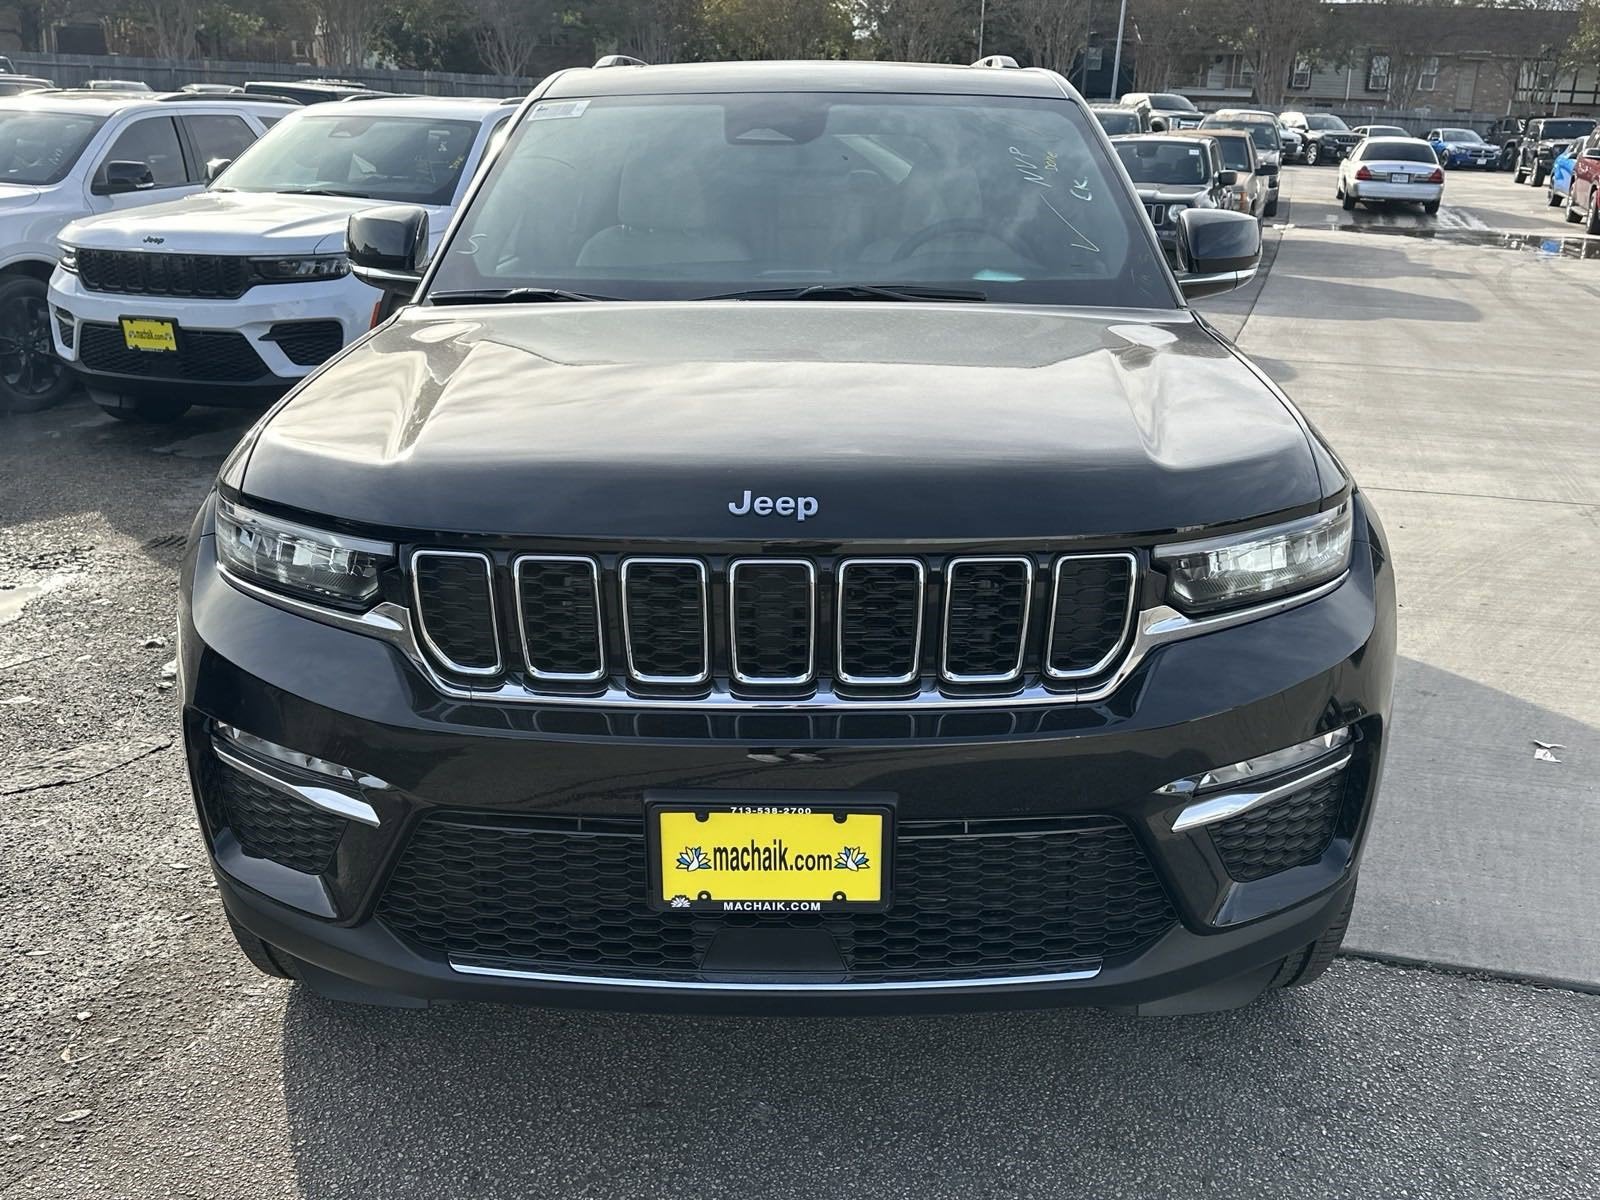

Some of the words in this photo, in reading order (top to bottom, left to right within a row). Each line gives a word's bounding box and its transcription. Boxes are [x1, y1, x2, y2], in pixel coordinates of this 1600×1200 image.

[728, 490, 819, 521] Jeep
[730, 807, 812, 815] 713-538-2700
[713, 839, 833, 872] machaik.com
[723, 901, 821, 911] MACHAIK.COM
